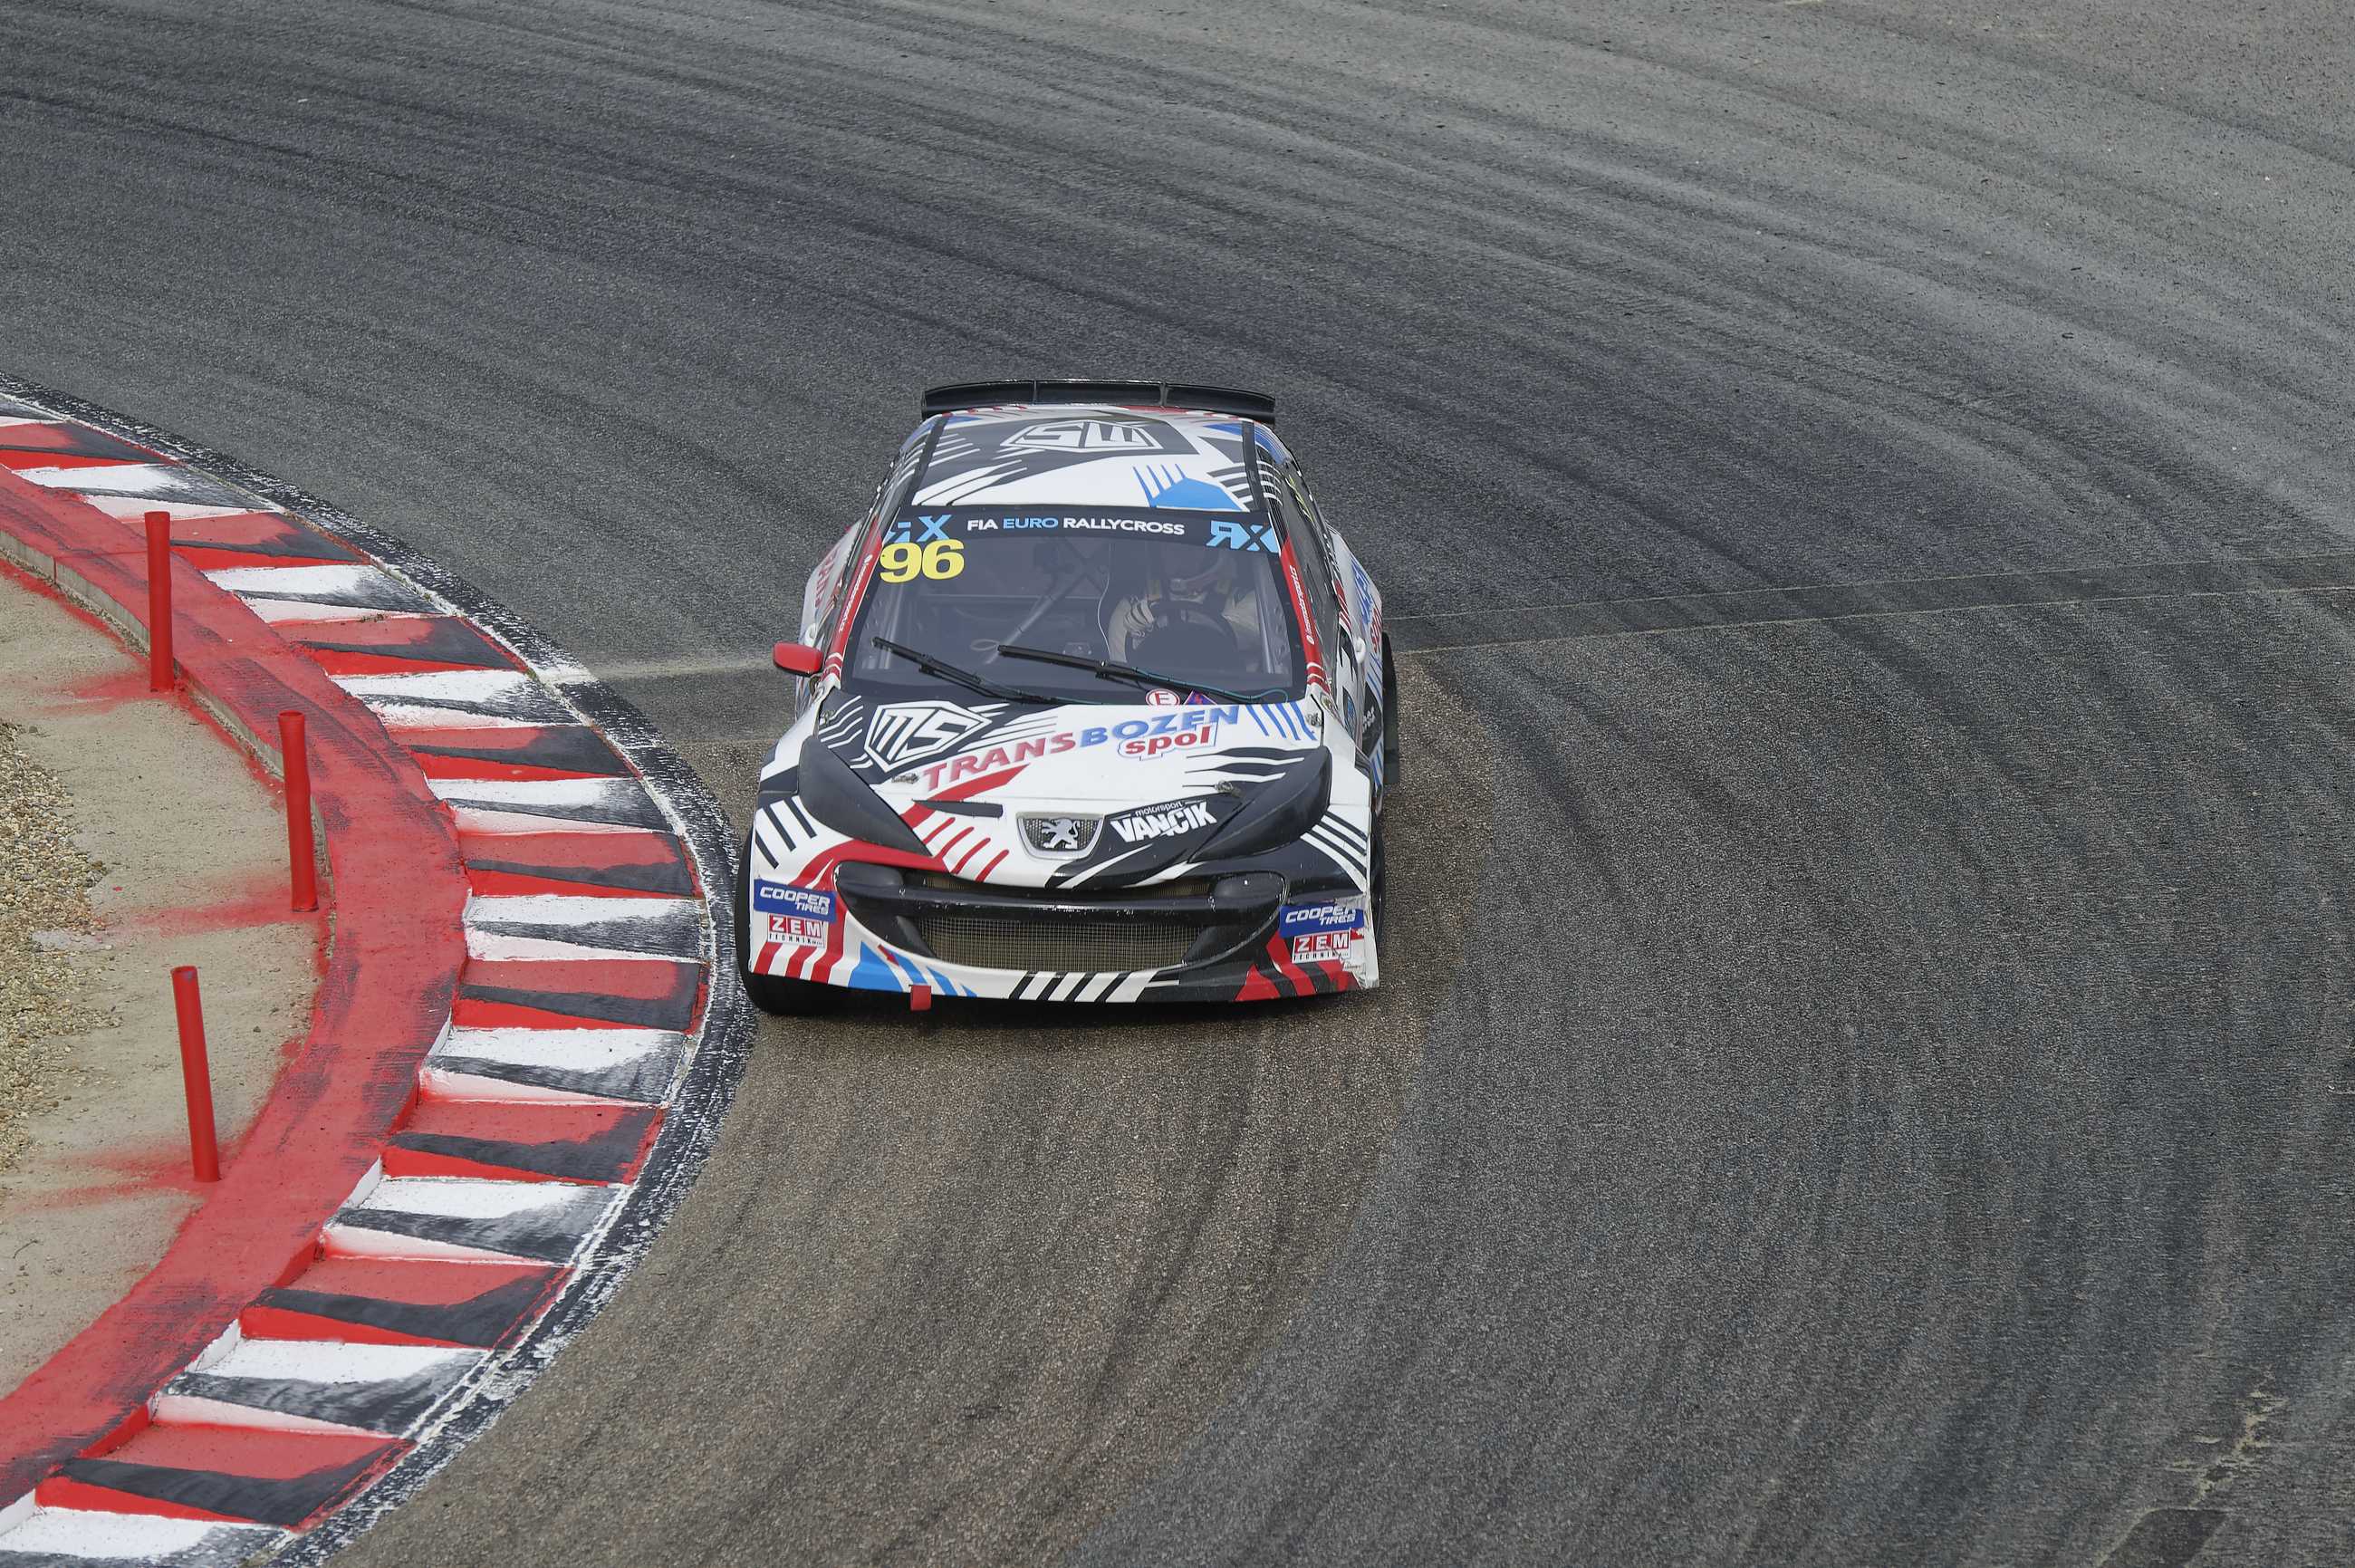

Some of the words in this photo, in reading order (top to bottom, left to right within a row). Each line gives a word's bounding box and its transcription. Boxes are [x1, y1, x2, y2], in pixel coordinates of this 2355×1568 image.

[967, 519, 998, 532] FIA
[1003, 517, 1059, 529] EURO
[1062, 517, 1185, 535] RALLYCROSS
[880, 539, 965, 583] 96
[1125, 725, 1211, 755] spol
[1134, 800, 1184, 817] motorsport
[759, 885, 831, 907] COOPER
[795, 902, 829, 916] TIRES
[771, 916, 822, 938] ZEM
[1319, 913, 1357, 926] TIRES
[1297, 933, 1349, 952] ZEM
